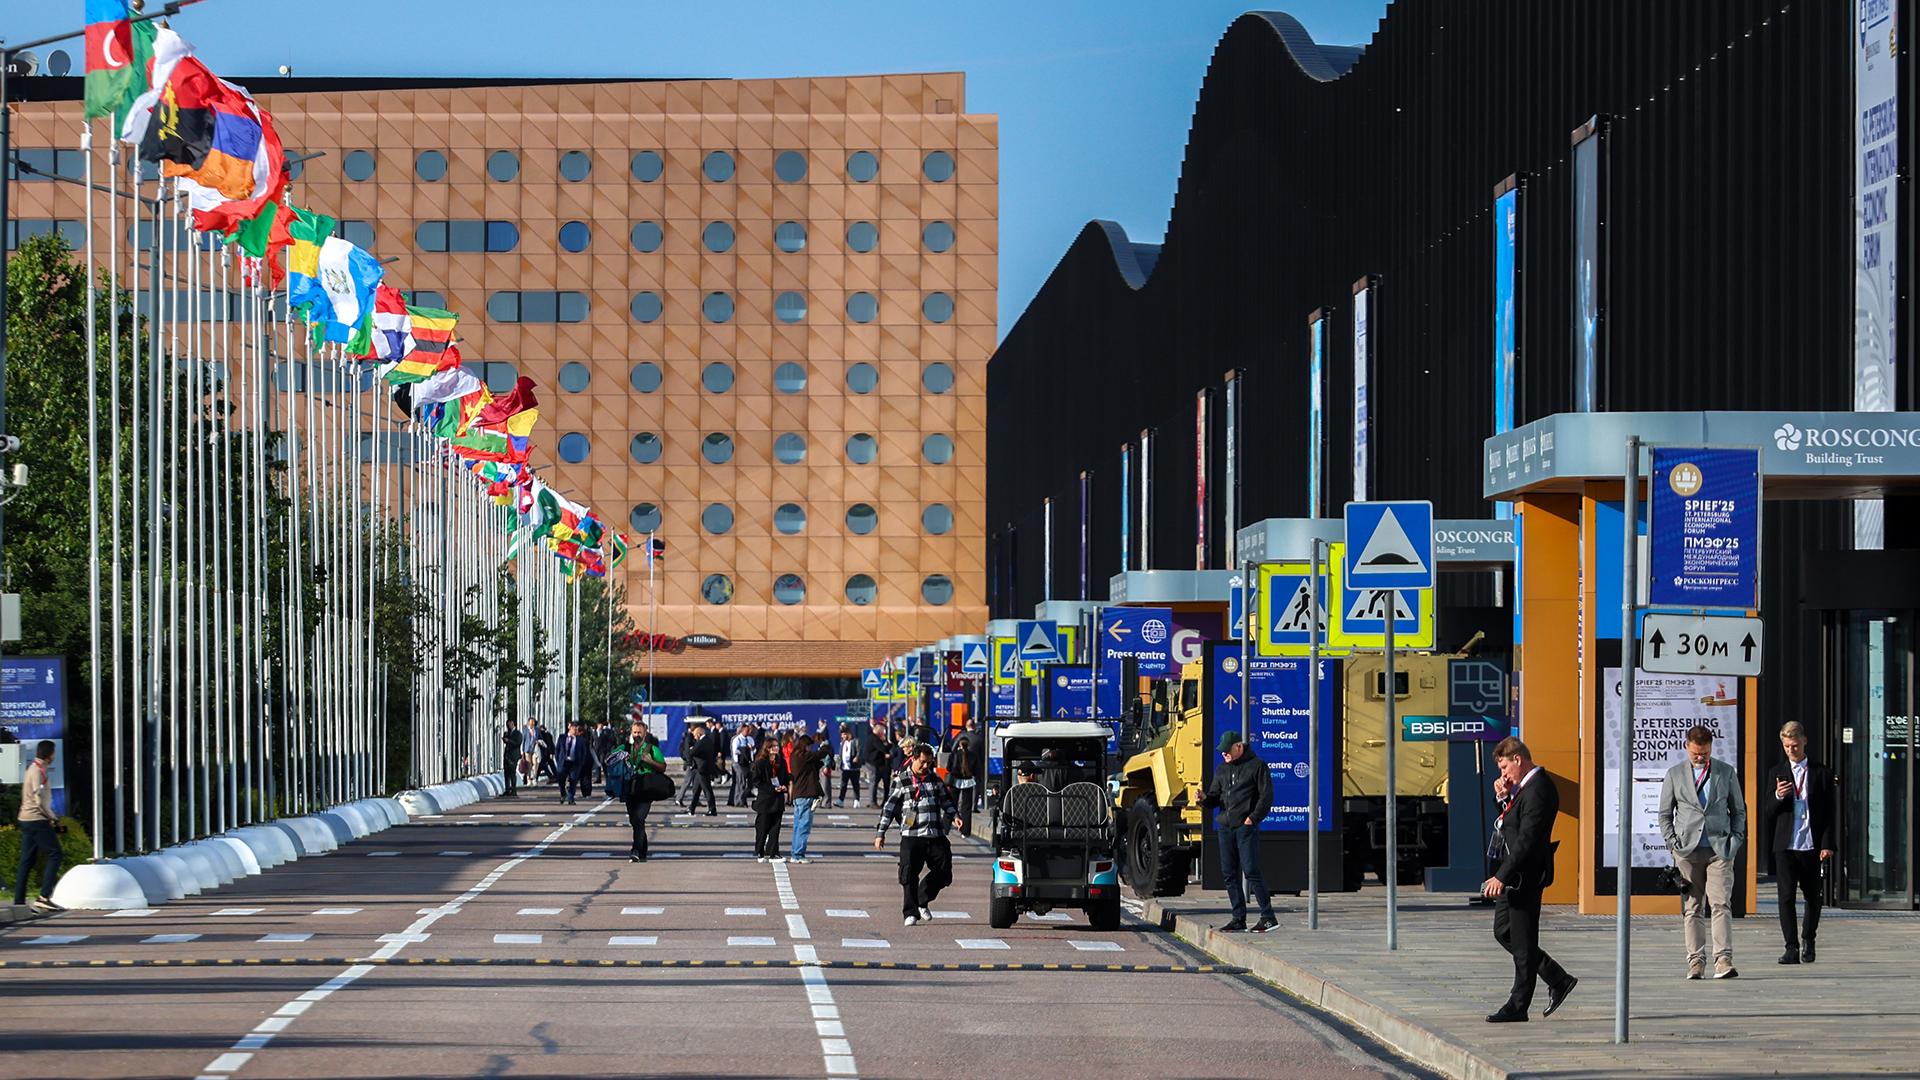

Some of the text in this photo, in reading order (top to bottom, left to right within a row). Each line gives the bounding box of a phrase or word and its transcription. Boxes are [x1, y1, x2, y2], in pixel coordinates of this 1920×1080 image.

[1806, 452, 1884, 468] Building Trust
[1434, 530, 1515, 544] OSCONGR
[1684, 559, 1739, 567] ЭКОНОМИЧЕСКИЙ
[1683, 576, 1739, 585] РОСКОНГРЕСС
[693, 636, 717, 644] Hilton
[1135, 650, 1166, 659] centre
[1262, 707, 1290, 716] Shuttle
[721, 711, 793, 723] ПЕТЕРБУРГСКИЙ
[1641, 718, 1719, 728] PETERSBURG
[1262, 731, 1298, 740] VinoGrad
[1632, 751, 1668, 762] ORUM
